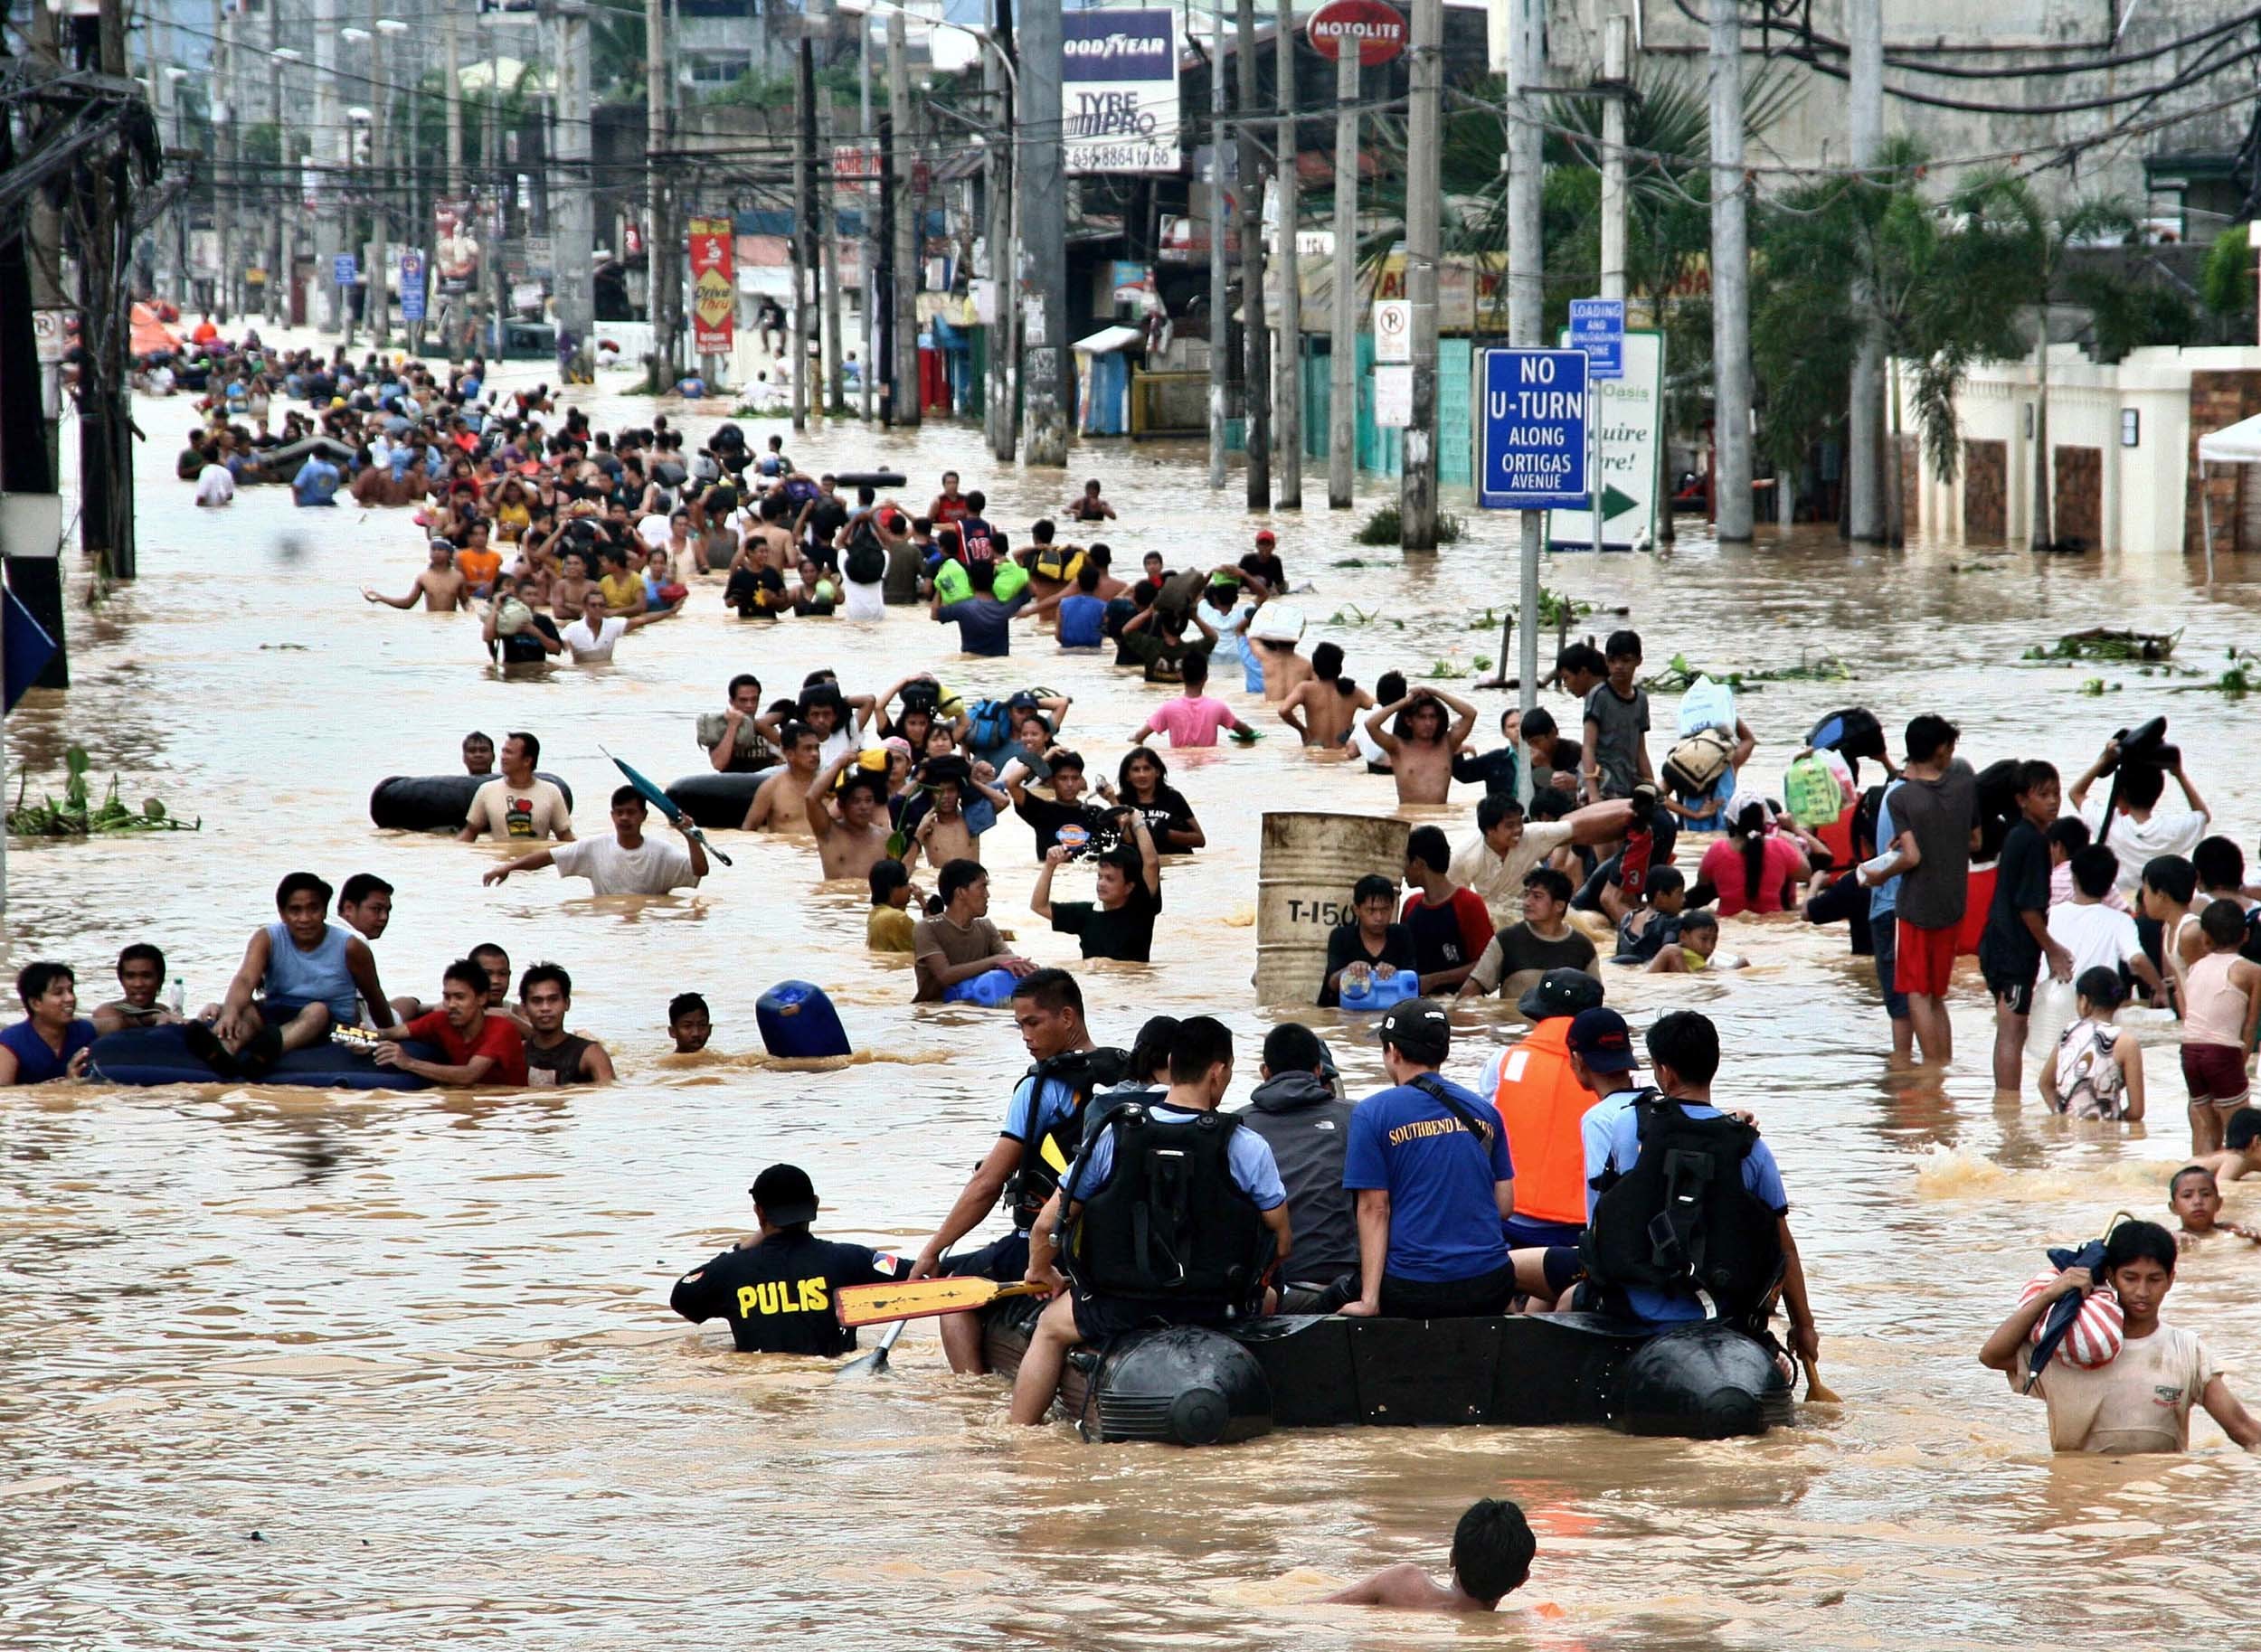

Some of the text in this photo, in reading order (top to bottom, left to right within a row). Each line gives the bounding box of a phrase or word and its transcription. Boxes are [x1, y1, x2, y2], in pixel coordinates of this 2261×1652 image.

[1315, 22, 1401, 38] MOTOLITE
[1063, 33, 1165, 59] OODYEAR
[695, 286, 730, 299] Drive
[700, 298, 730, 311] Thru
[1573, 304, 1621, 316] LOADING
[1520, 356, 1555, 383] NO
[1491, 391, 1582, 420] U-TURN
[1509, 427, 1565, 447] ALONG
[1502, 453, 1571, 474] ORTIGAS
[1510, 473, 1562, 489] AVENUE
[1629, 870, 1639, 884] 3
[1388, 1119, 1453, 1147] SOUTHBEND
[737, 1276, 828, 1318] PULIS
